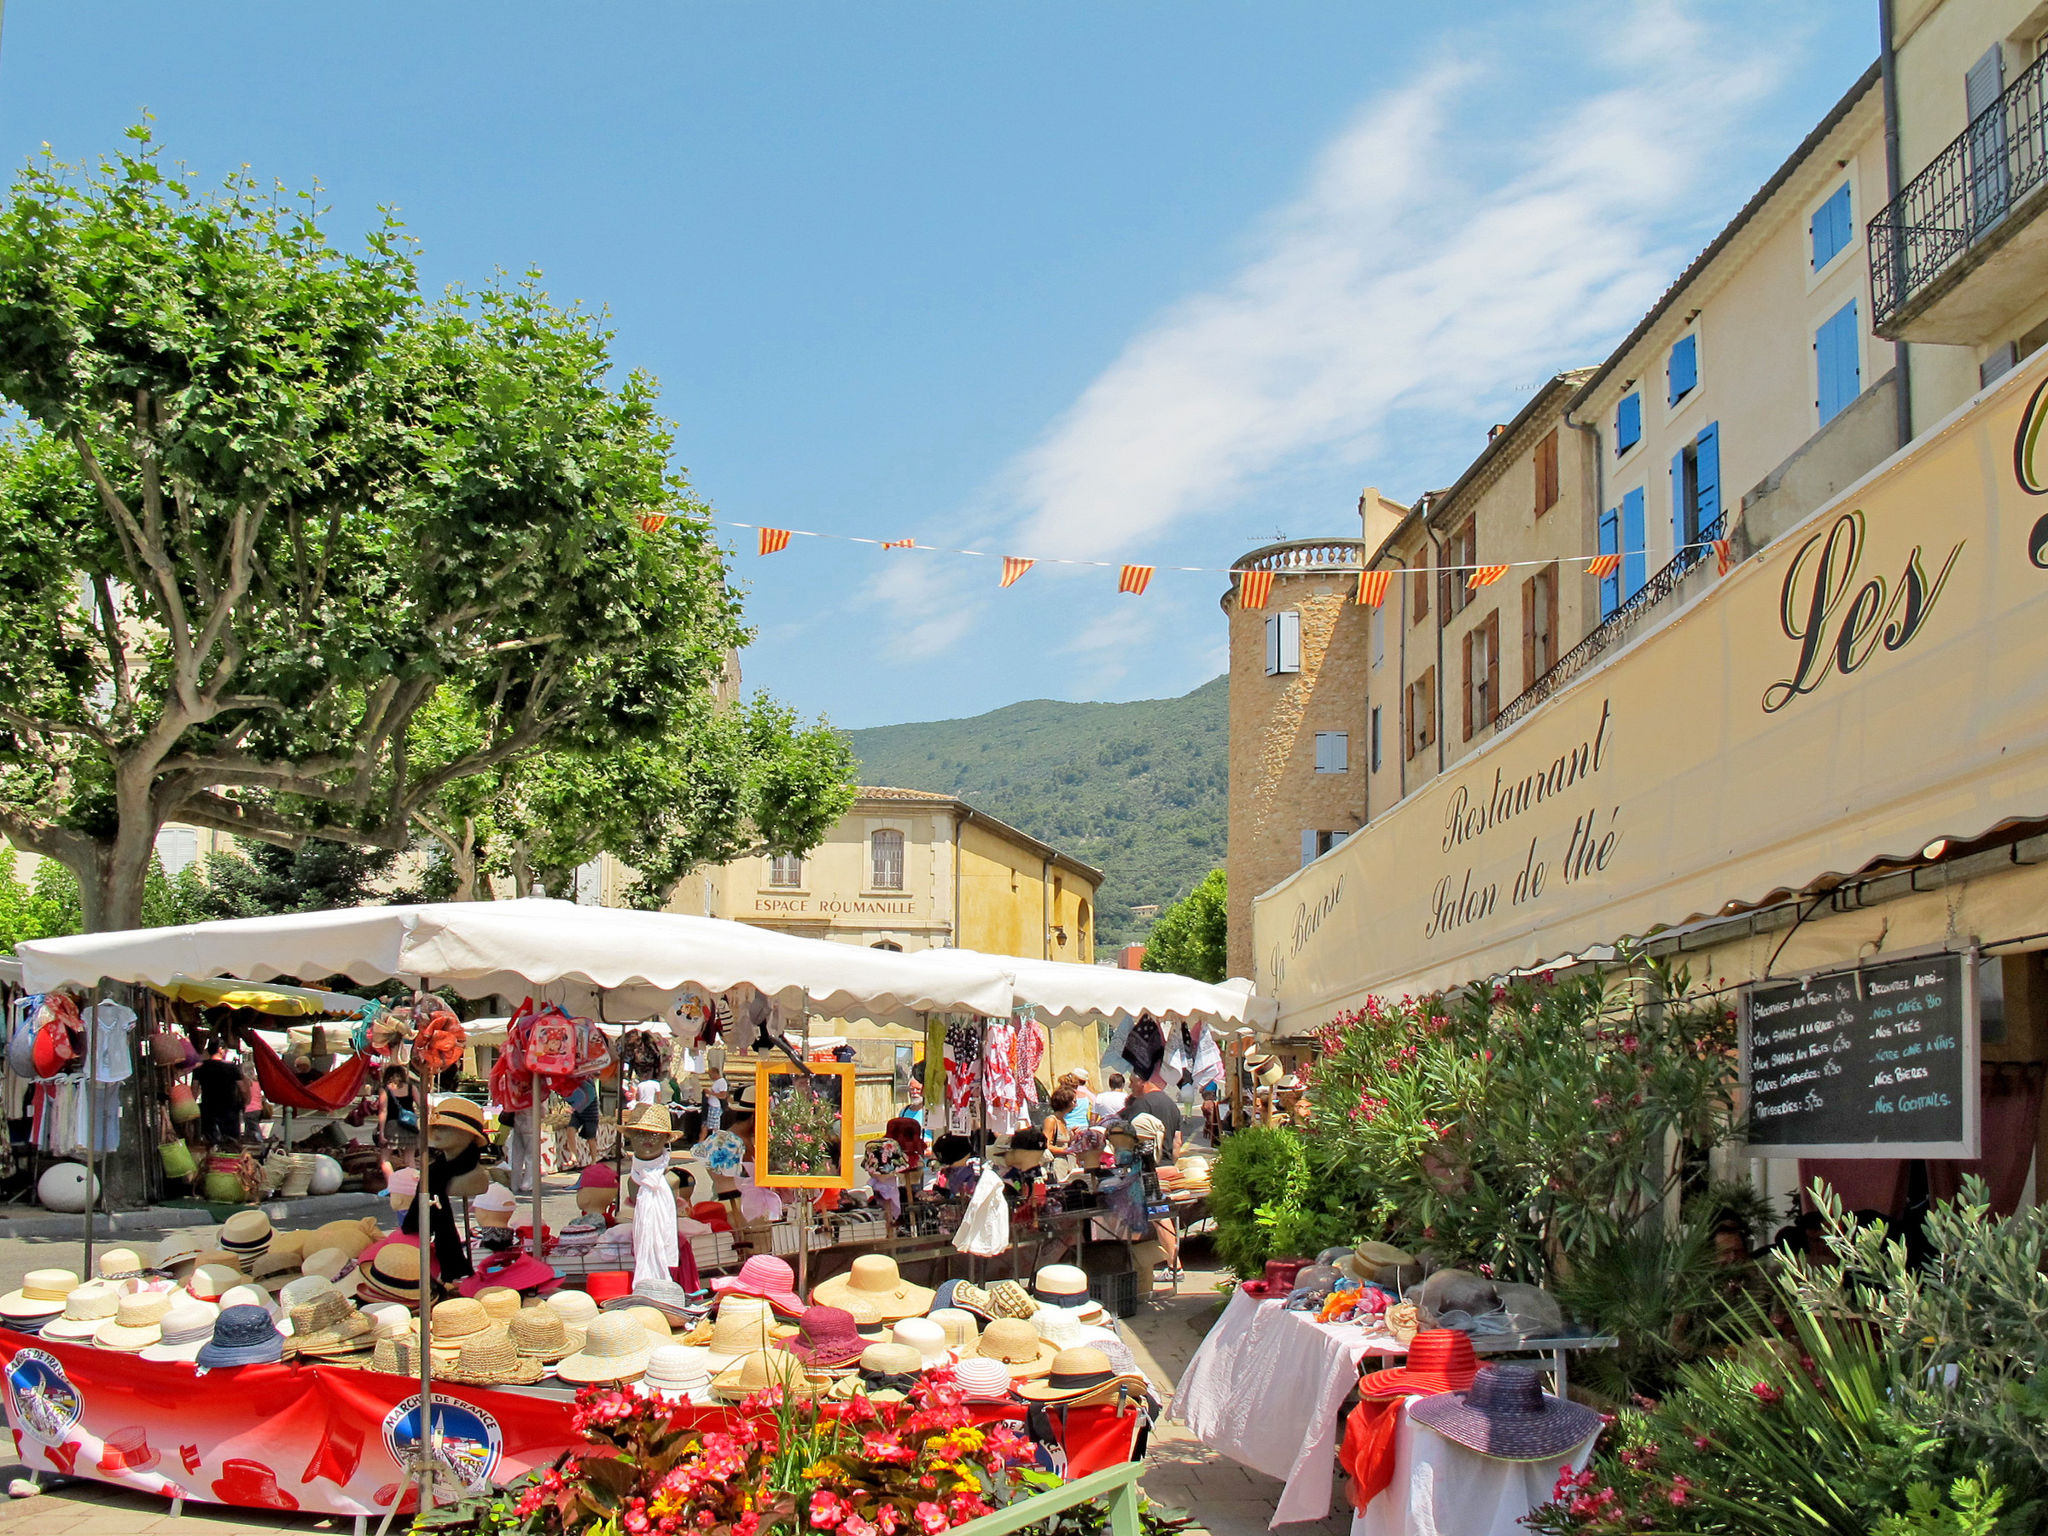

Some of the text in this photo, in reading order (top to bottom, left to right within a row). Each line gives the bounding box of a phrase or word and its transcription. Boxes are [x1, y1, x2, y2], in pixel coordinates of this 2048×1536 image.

[1762, 509, 1967, 714] Les
[1441, 698, 1613, 854] Restaurant
[755, 899, 916, 914] ESPACE ROUMANILLE
[1425, 805, 1624, 940] Salon de thé
[434, 1394, 451, 1404] DE
[453, 1399, 497, 1430] FRANCE
